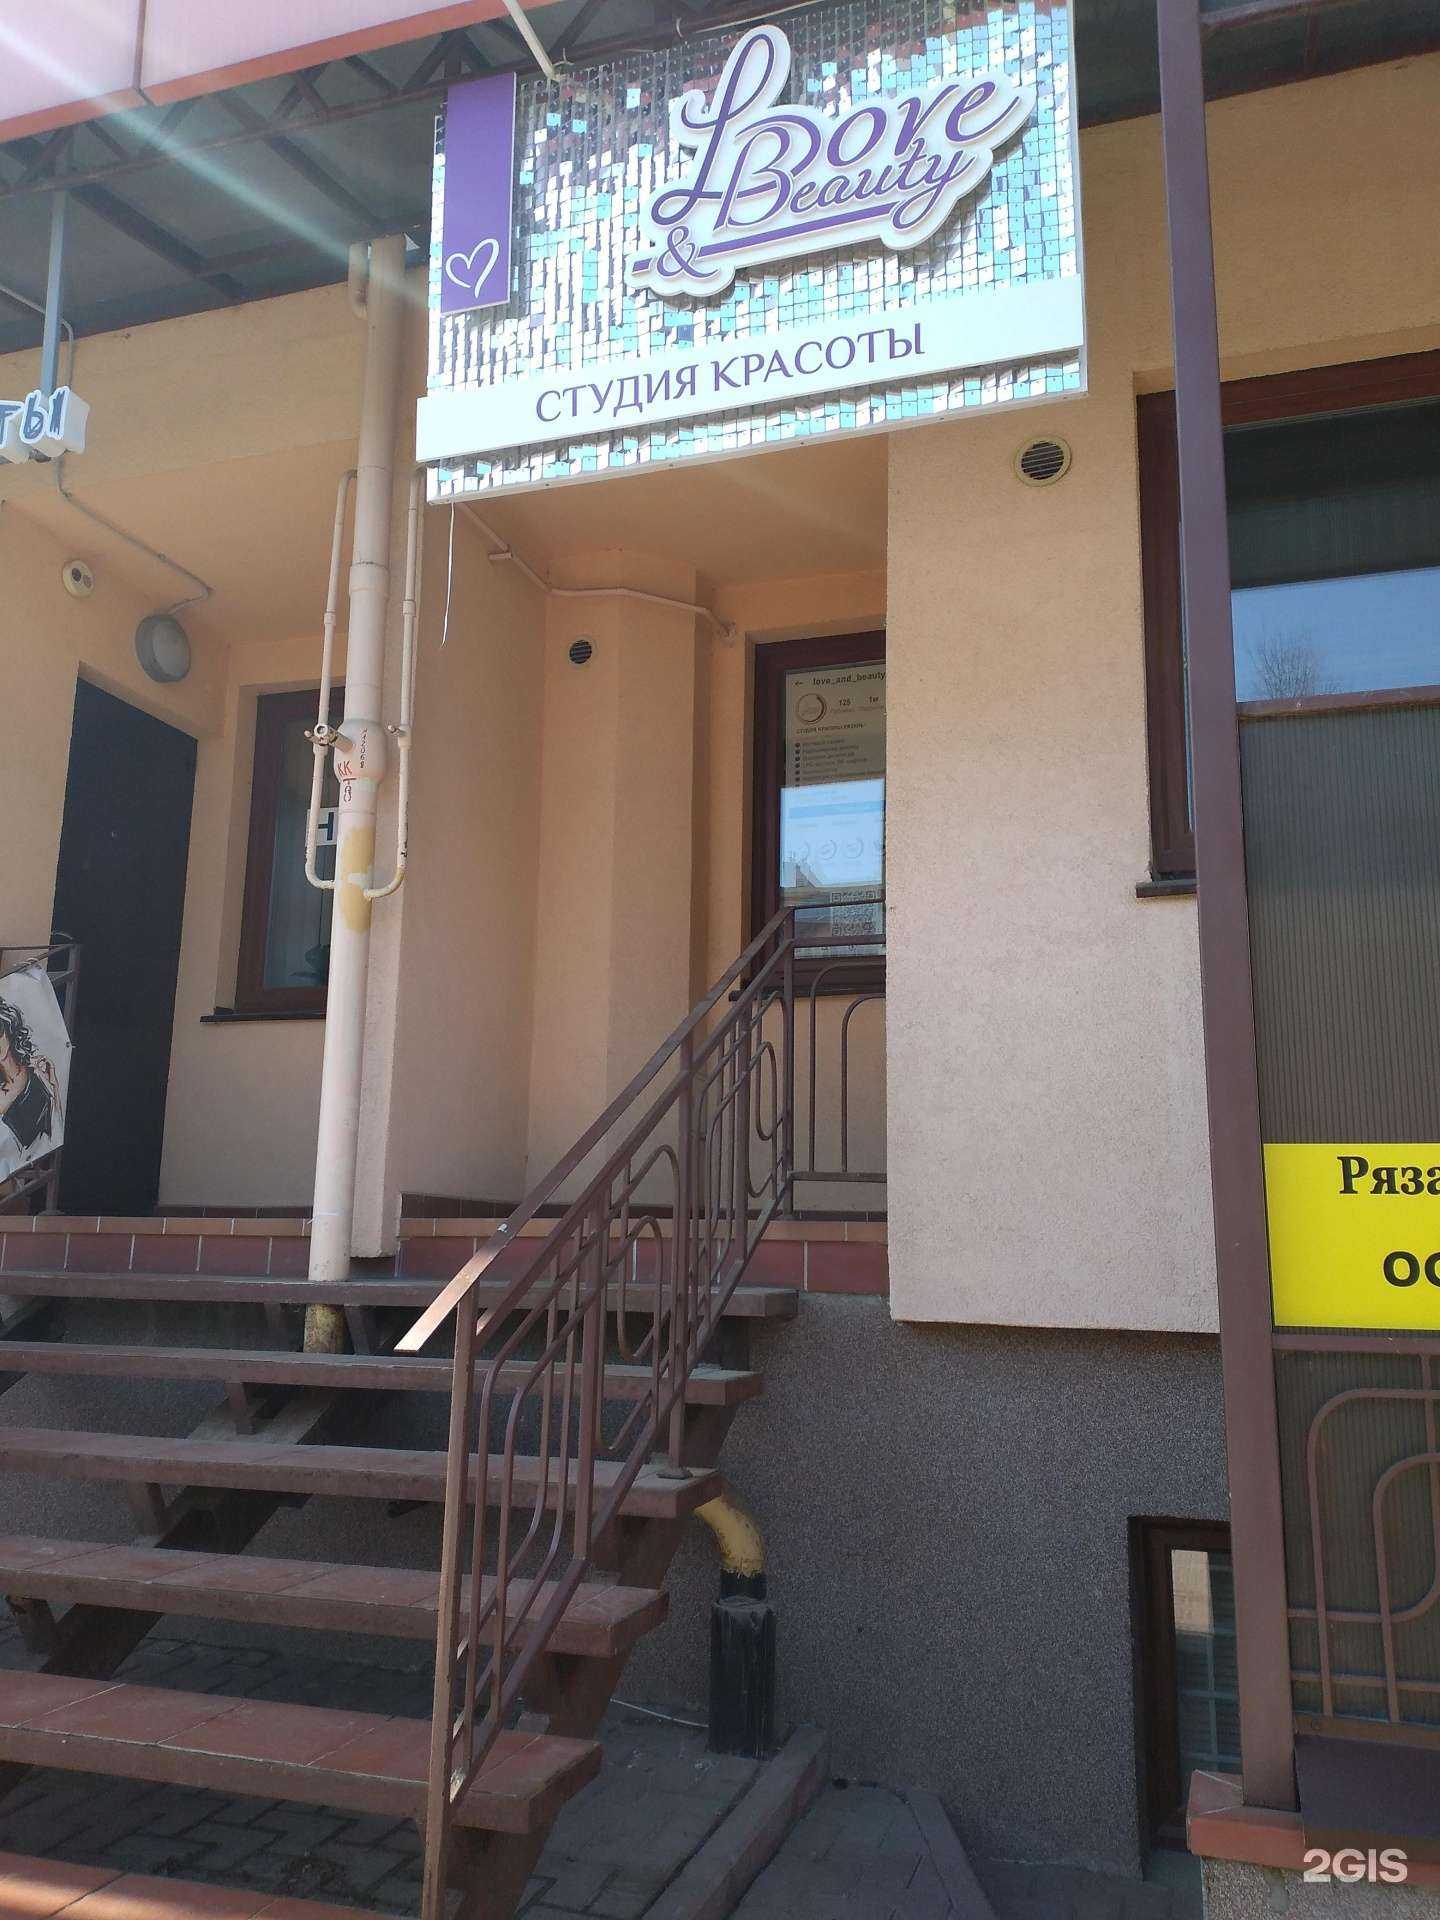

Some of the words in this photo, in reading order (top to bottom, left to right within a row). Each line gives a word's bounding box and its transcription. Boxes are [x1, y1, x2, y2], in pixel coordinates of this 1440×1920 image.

[650, 33, 1021, 226] Love
[712, 115, 975, 231] Beauty
[535, 364, 697, 423] СТУДИЯ
[710, 322, 926, 392] КРАСОТЫ
